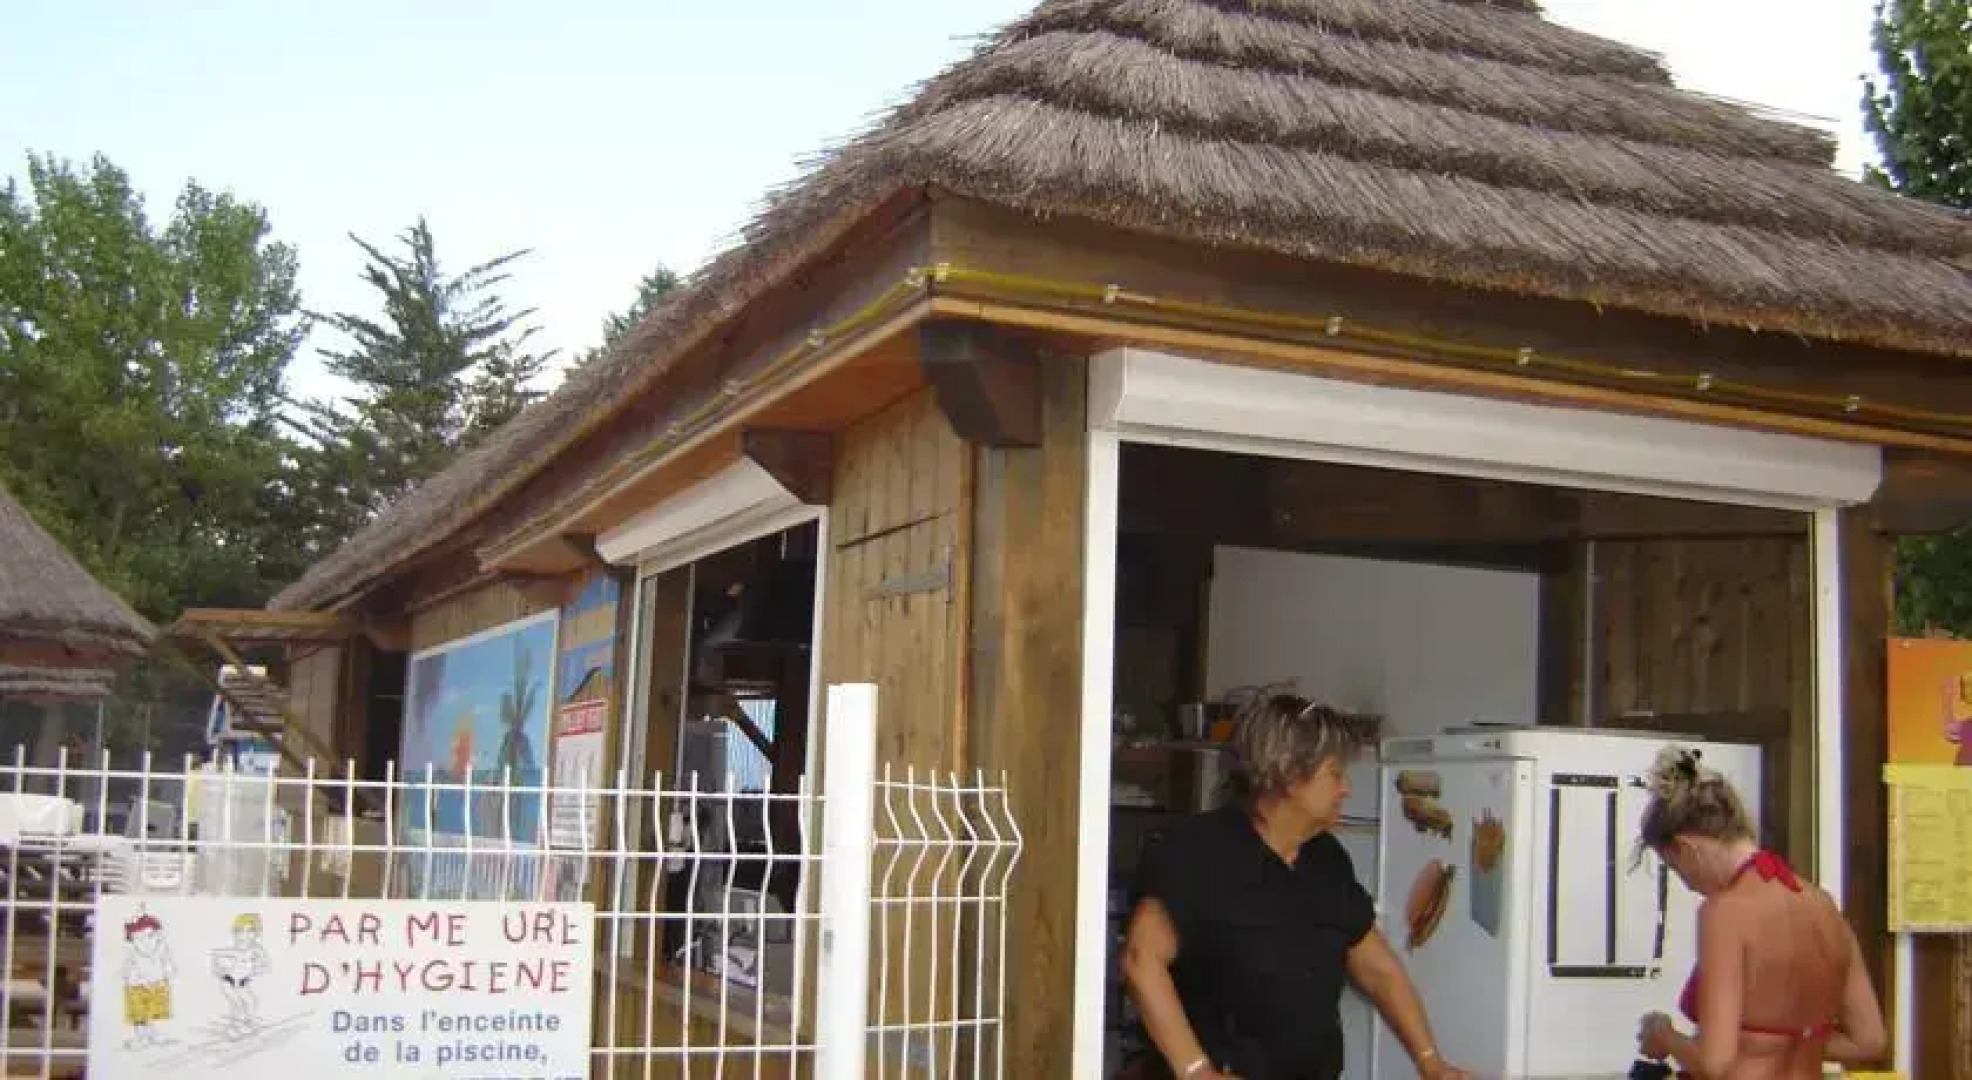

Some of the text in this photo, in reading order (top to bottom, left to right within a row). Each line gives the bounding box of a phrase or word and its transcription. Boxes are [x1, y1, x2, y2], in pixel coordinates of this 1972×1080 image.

[289, 911, 381, 946] PAR
[300, 958, 572, 996] D'HYGIENE
[332, 1009, 562, 1033] Dans l'enceinte
[345, 1041, 548, 1067] de la piscine,
